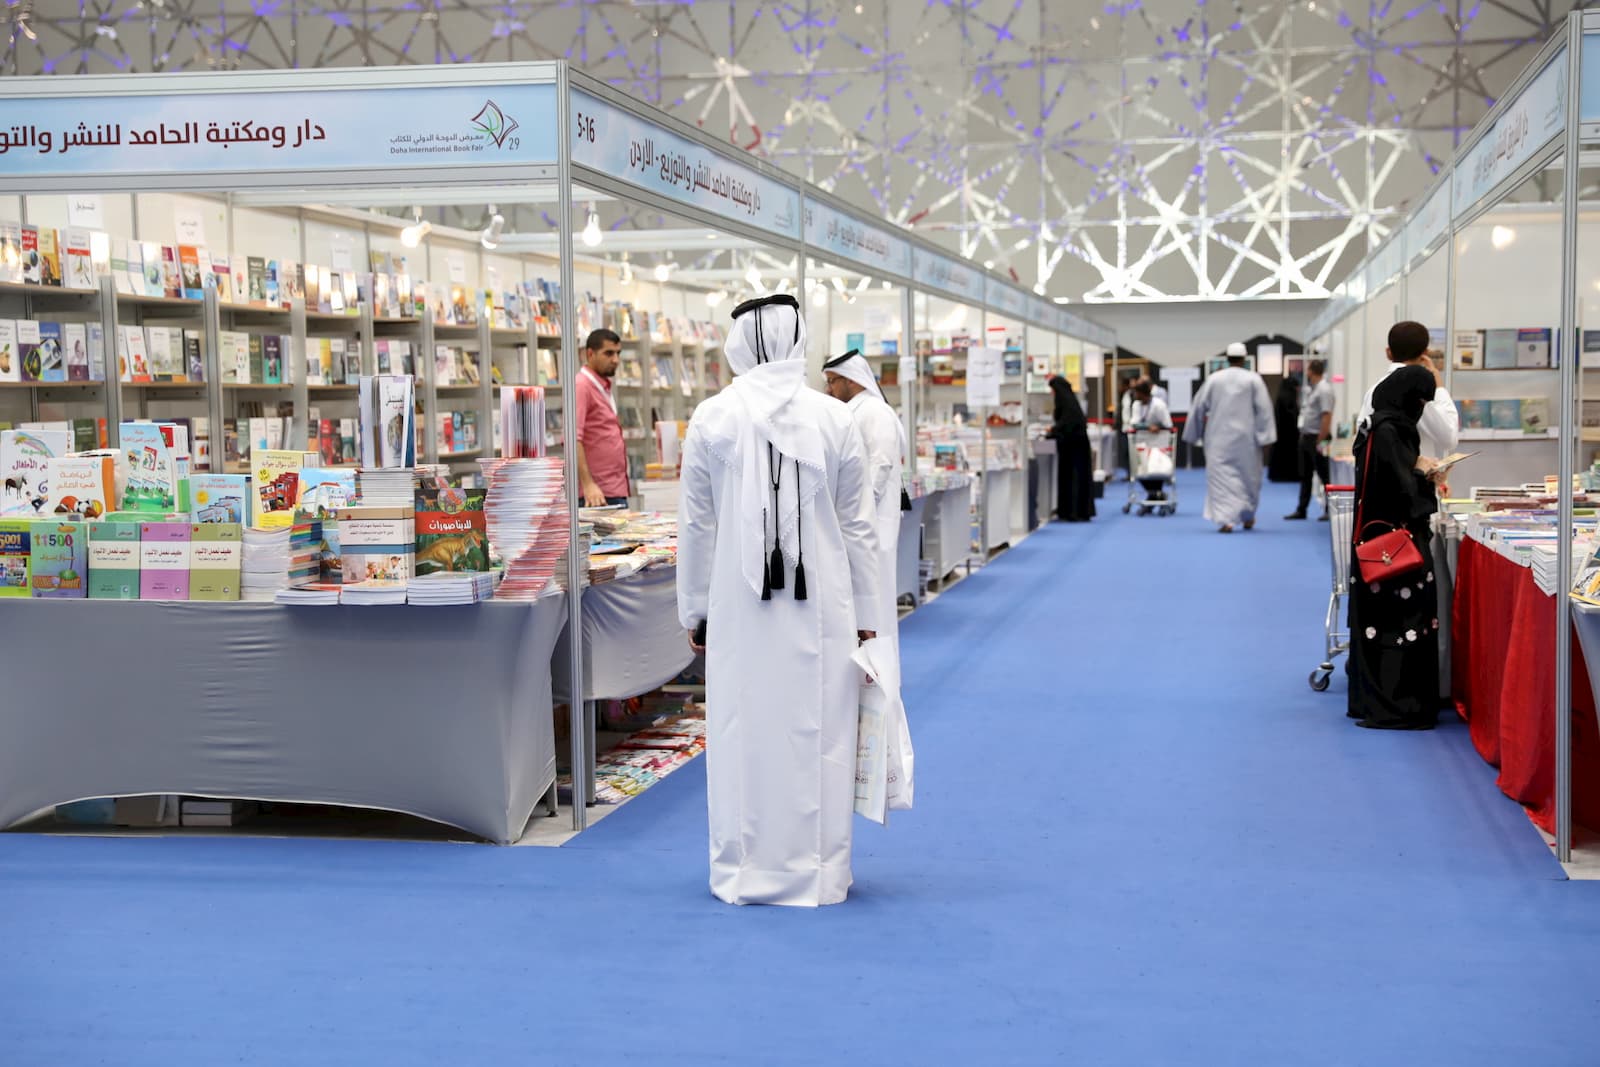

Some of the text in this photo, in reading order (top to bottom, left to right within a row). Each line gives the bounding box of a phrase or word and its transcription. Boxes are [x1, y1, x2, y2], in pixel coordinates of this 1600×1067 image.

[59, 121, 121, 153] للنشر
[128, 122, 198, 145] الحامد
[206, 120, 285, 148] ومكتبة
[293, 119, 325, 148] دار
[390, 133, 484, 144] معرض الدوحة الدولي للكتاب
[577, 112, 594, 143] 5-16
[409, 145, 452, 153] International
[509, 137, 520, 150] 29
[660, 151, 690, 190] والتوزيع
[692, 160, 710, 192] للنشر
[752, 186, 760, 215] دار
[429, 519, 472, 531] للديناصورات
